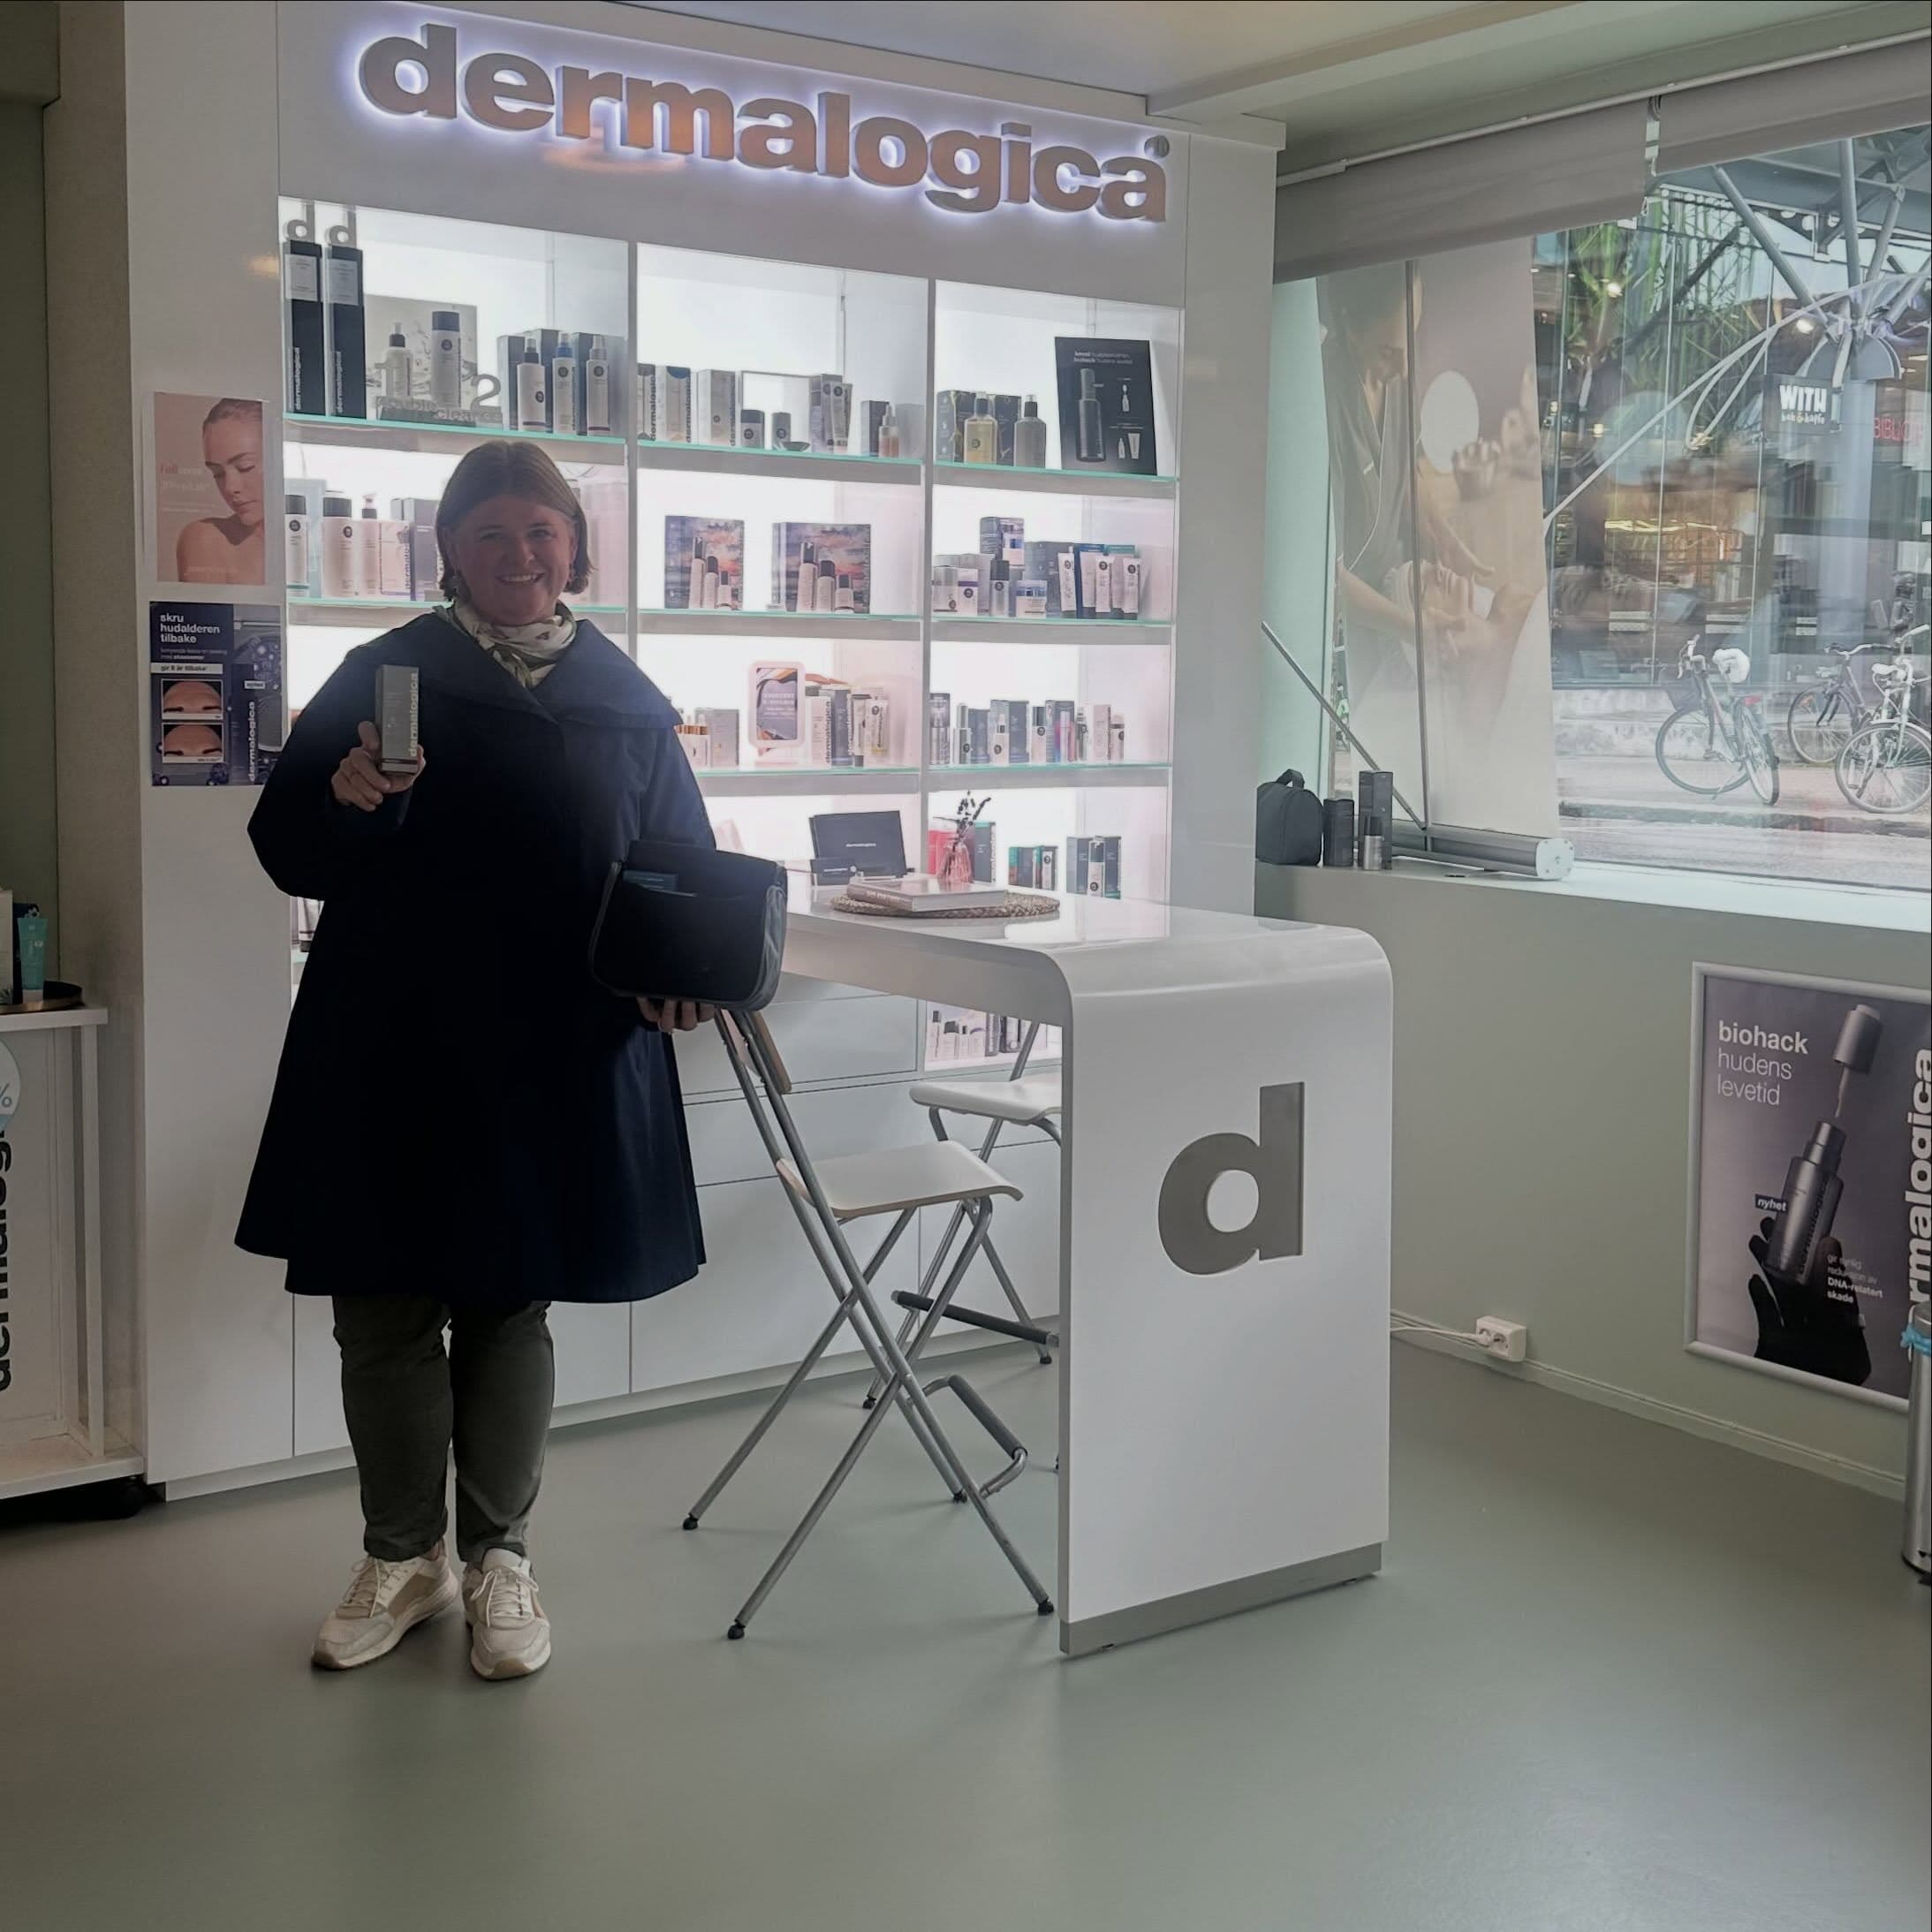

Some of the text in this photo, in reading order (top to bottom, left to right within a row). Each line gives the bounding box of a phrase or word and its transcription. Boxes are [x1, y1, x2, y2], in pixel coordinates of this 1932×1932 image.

[358, 24, 1167, 223] dermalogica
[1779, 385, 1827, 413] WITH
[160, 613, 184, 623] skru
[160, 623, 220, 633] hudalderen
[161, 633, 197, 643] tilbake
[1718, 1020, 1808, 1055] biohack
[1718, 1047, 1792, 1080] hudens
[1717, 1073, 1780, 1105] levetid
[1158, 1081, 1305, 1276] d
[1758, 1199, 1786, 1211] nyhet
